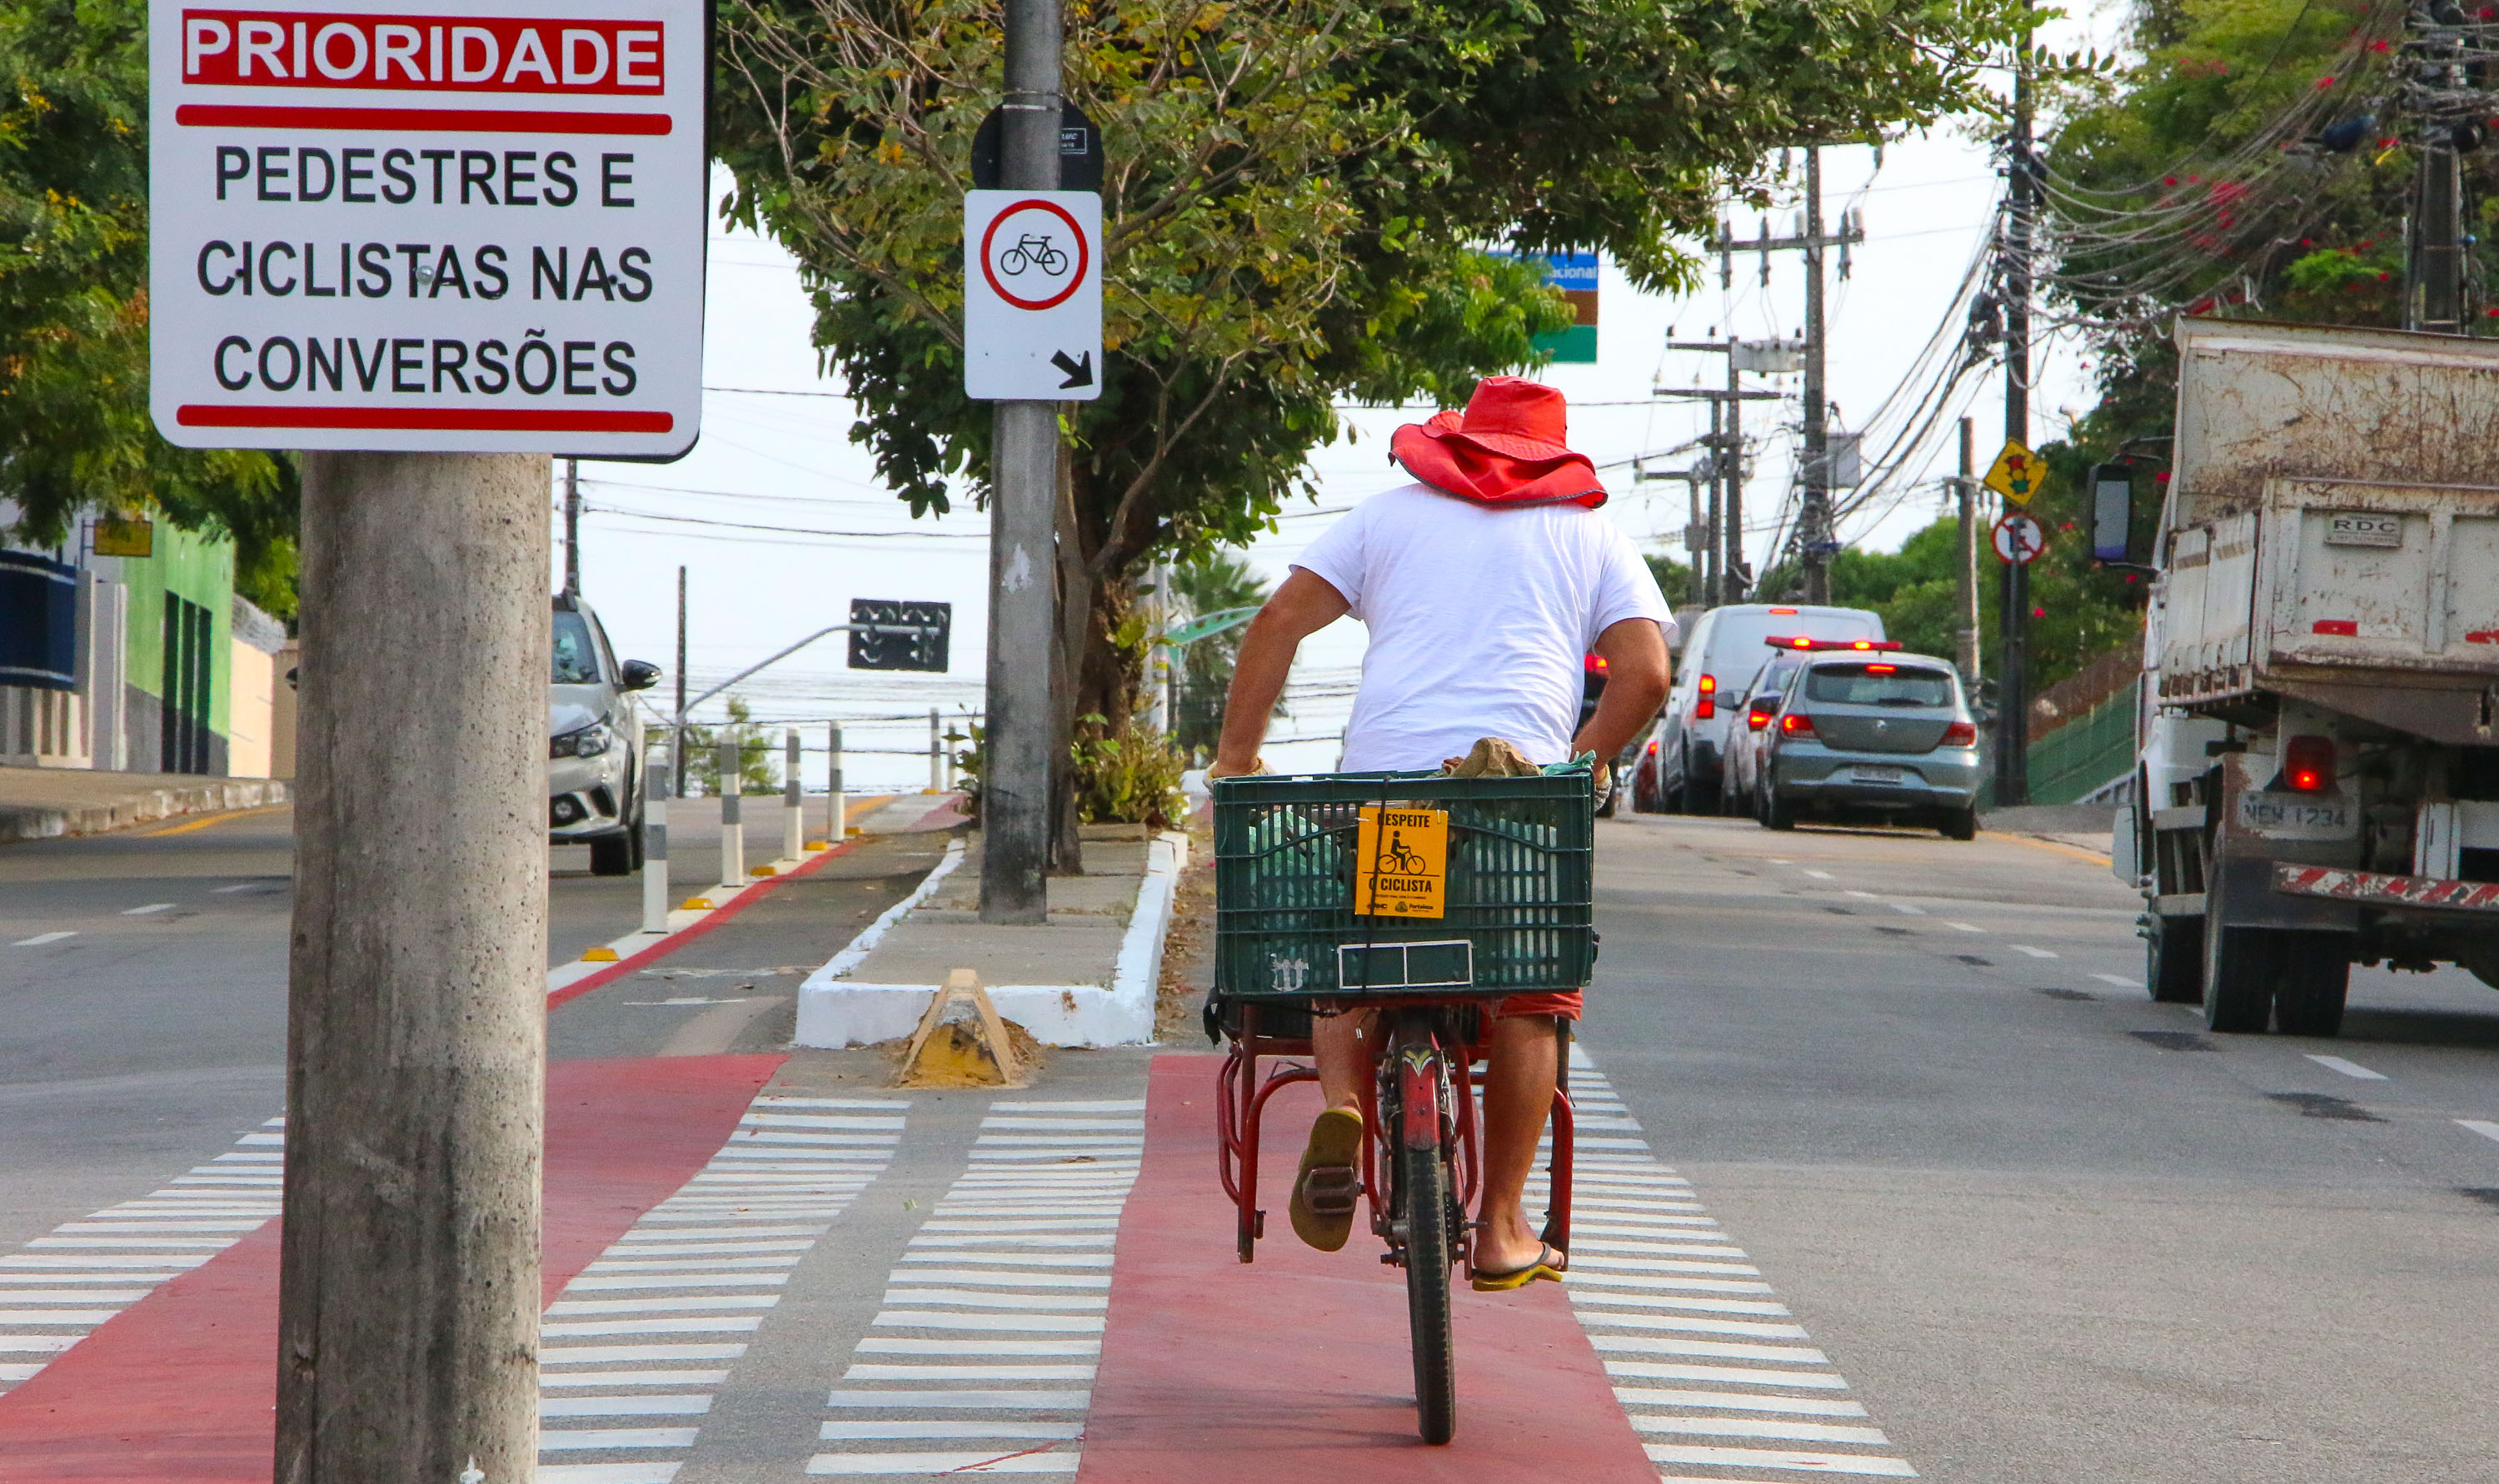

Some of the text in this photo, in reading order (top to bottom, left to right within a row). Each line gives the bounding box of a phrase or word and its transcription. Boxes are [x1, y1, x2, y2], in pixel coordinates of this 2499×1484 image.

[186, 18, 661, 87] PRIORIDADE
[215, 146, 636, 207] PEDESTRES E
[197, 240, 653, 302] CICLISTAS NAS
[1550, 265, 1598, 279] acional
[213, 327, 637, 397] CONVERSÕES
[2333, 520, 2396, 532] RDC
[1380, 878, 1432, 893] CICLISTA
